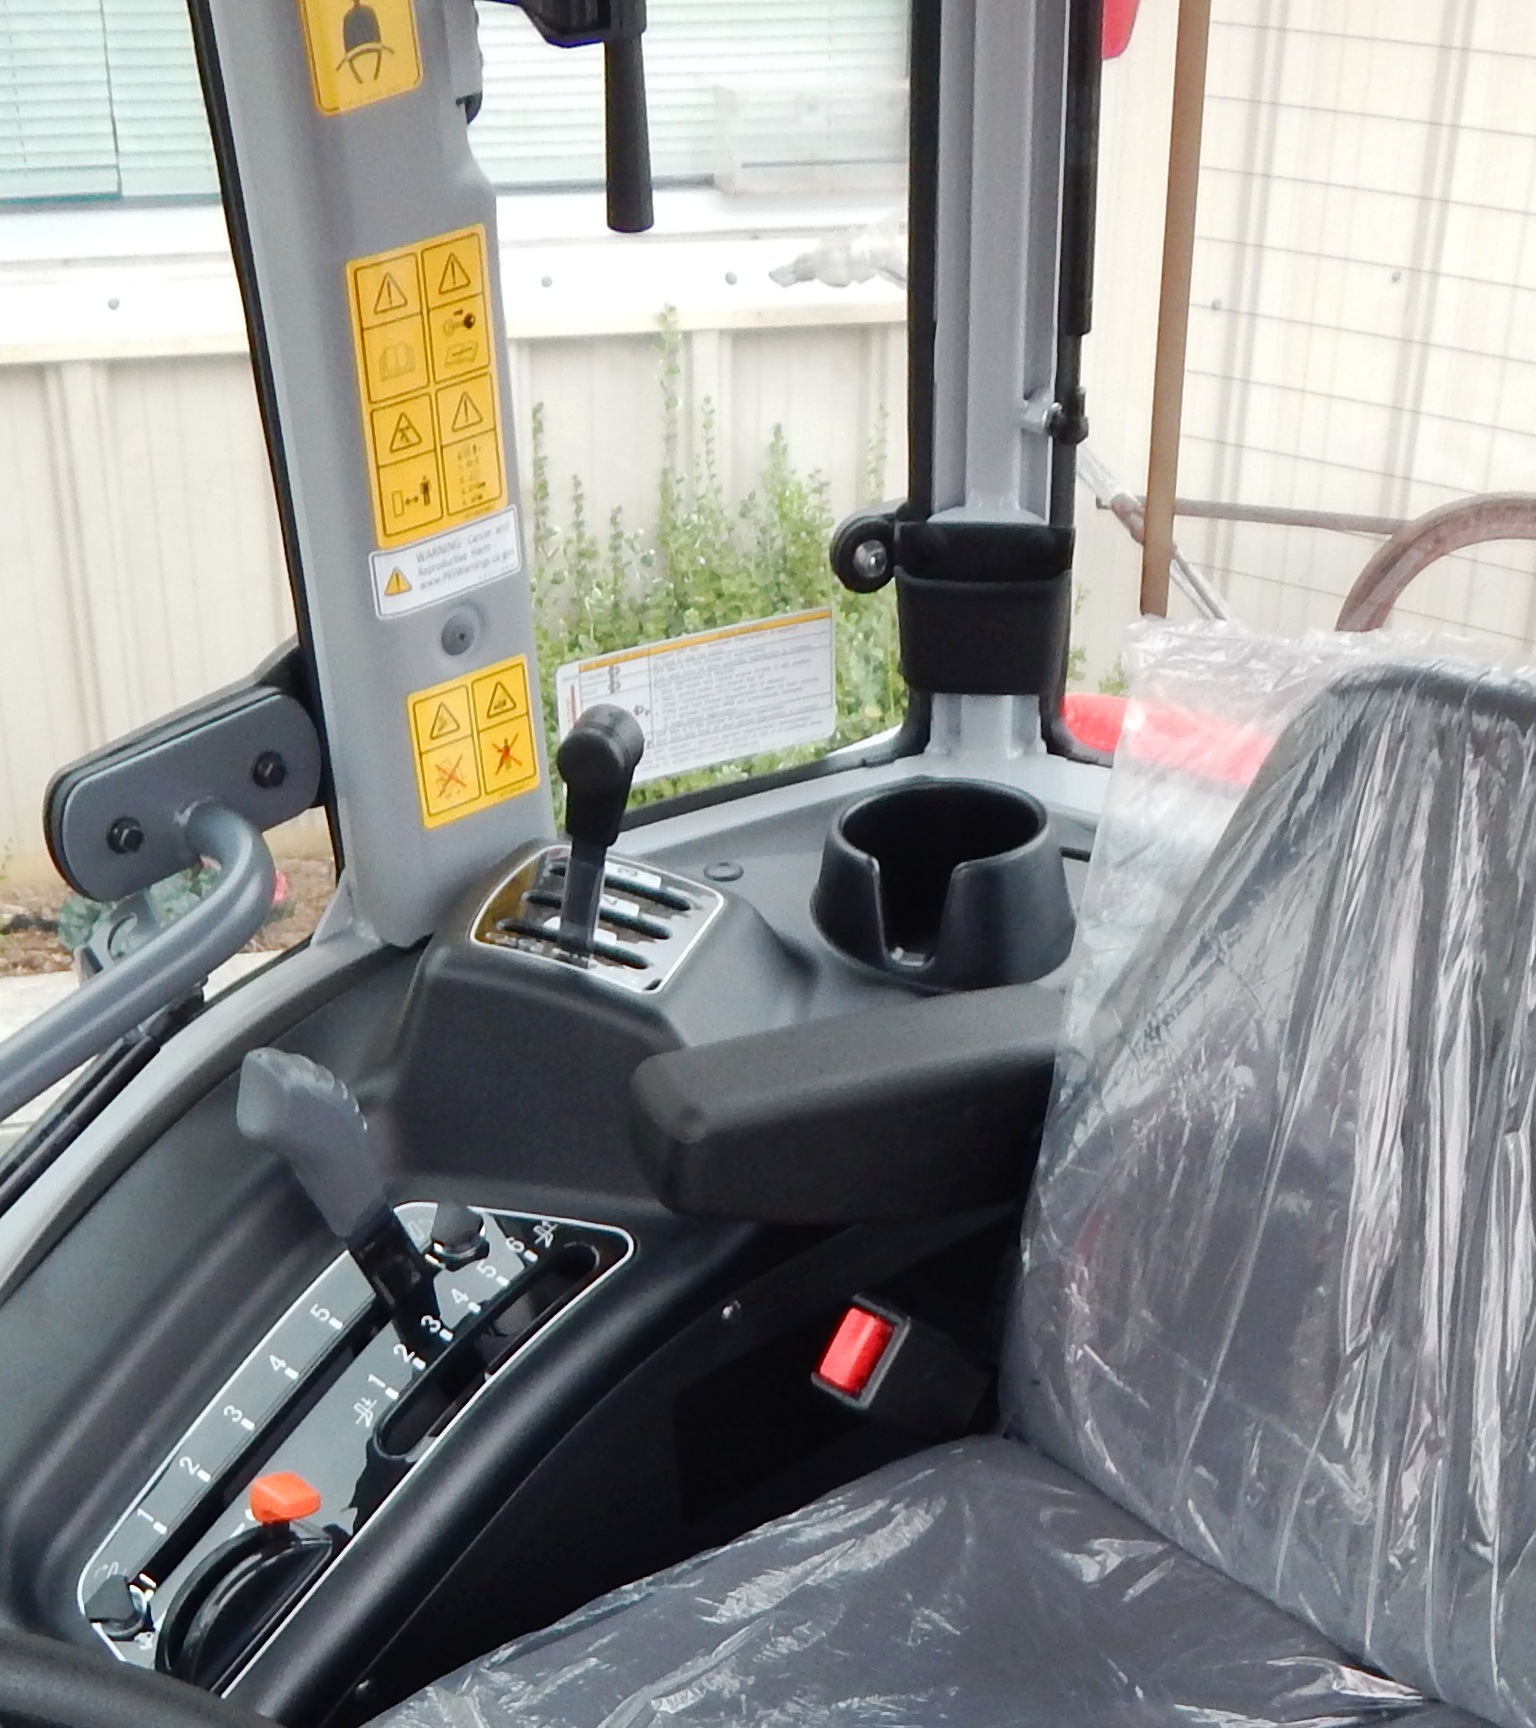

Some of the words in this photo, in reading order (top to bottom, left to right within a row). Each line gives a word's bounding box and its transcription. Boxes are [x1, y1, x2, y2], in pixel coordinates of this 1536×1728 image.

[505, 1236, 525, 1253] 6
[476, 1260, 497, 1278] 5
[451, 1288, 469, 1305] 4
[310, 1303, 330, 1321] 5
[420, 1315, 441, 1333] 3
[393, 1343, 415, 1363] 2
[269, 1354, 286, 1371] 4
[368, 1374, 385, 1388] 1
[223, 1405, 243, 1422] 3
[178, 1456, 200, 1475] 2
[136, 1508, 154, 1522] 1
